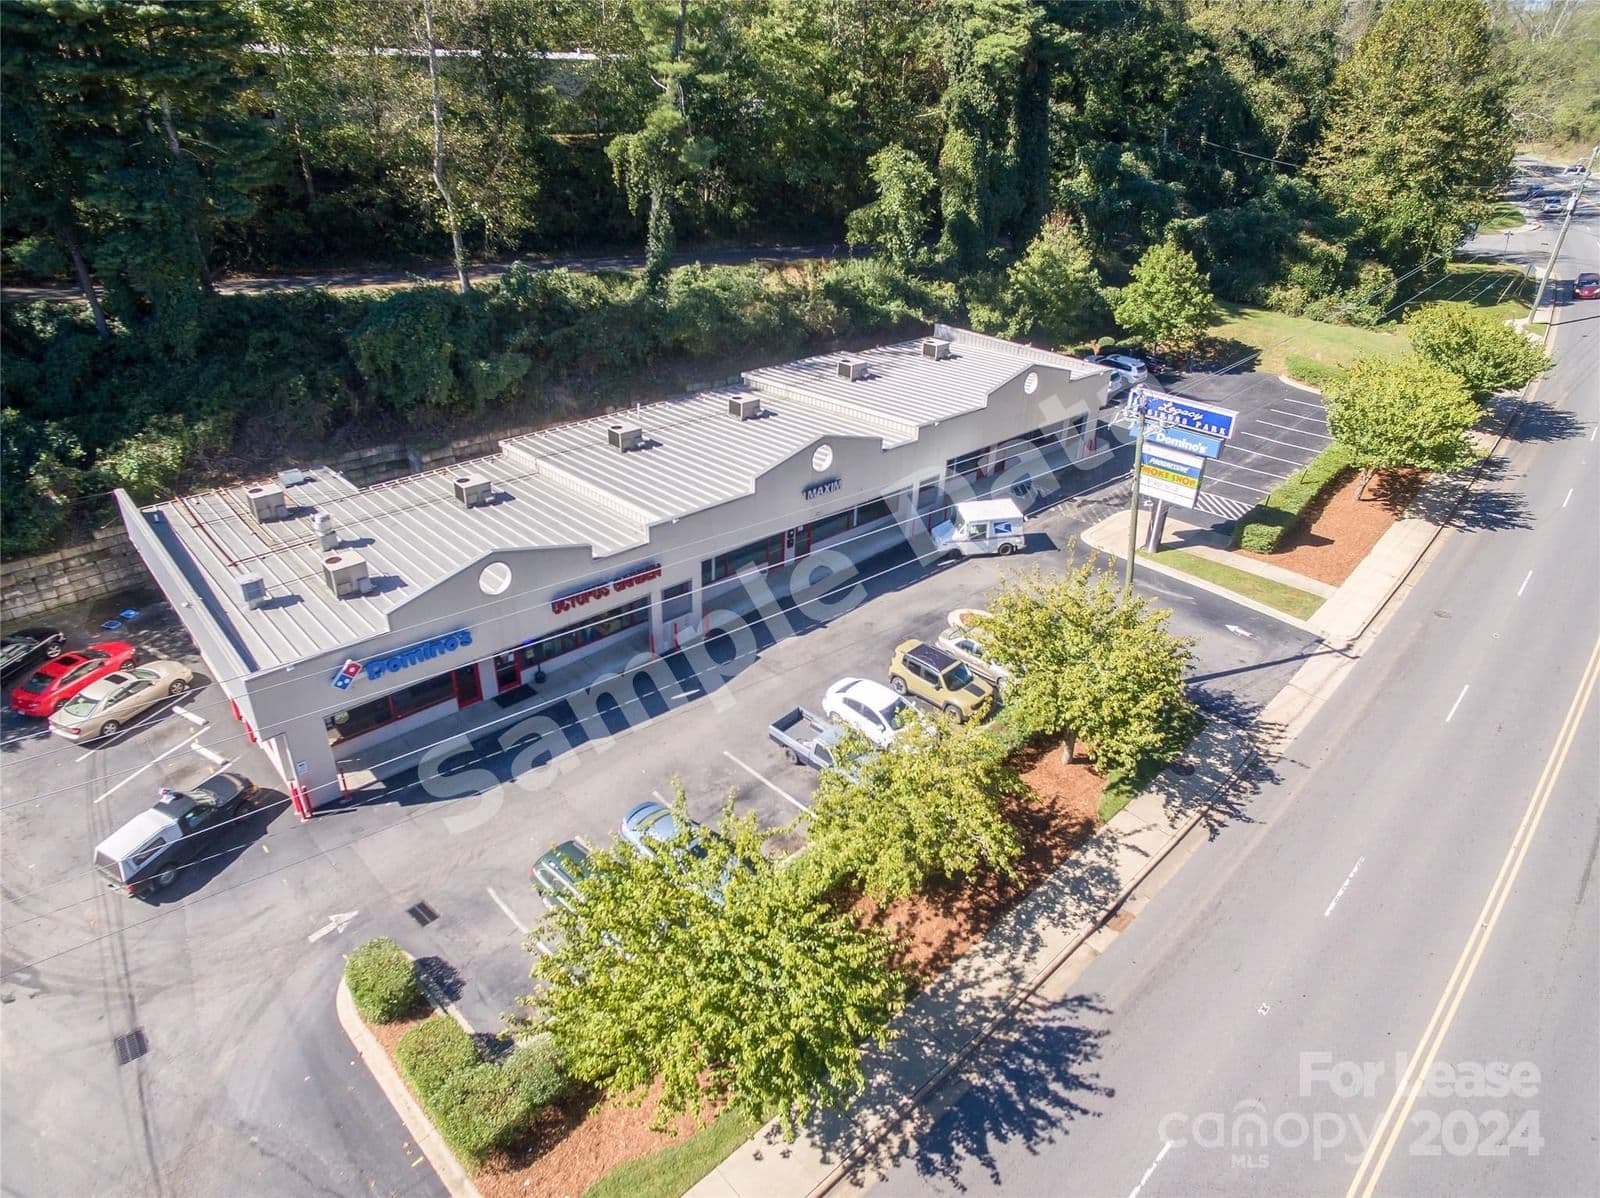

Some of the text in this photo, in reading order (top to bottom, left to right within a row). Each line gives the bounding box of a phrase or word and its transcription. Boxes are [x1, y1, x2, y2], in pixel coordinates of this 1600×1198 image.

[1195, 421, 1227, 436] PARK
[1155, 432, 1208, 453] Domino's
[1141, 466, 1169, 480] MOKE
[1172, 474, 1196, 487] SHOP
[805, 478, 841, 500] MAXIM
